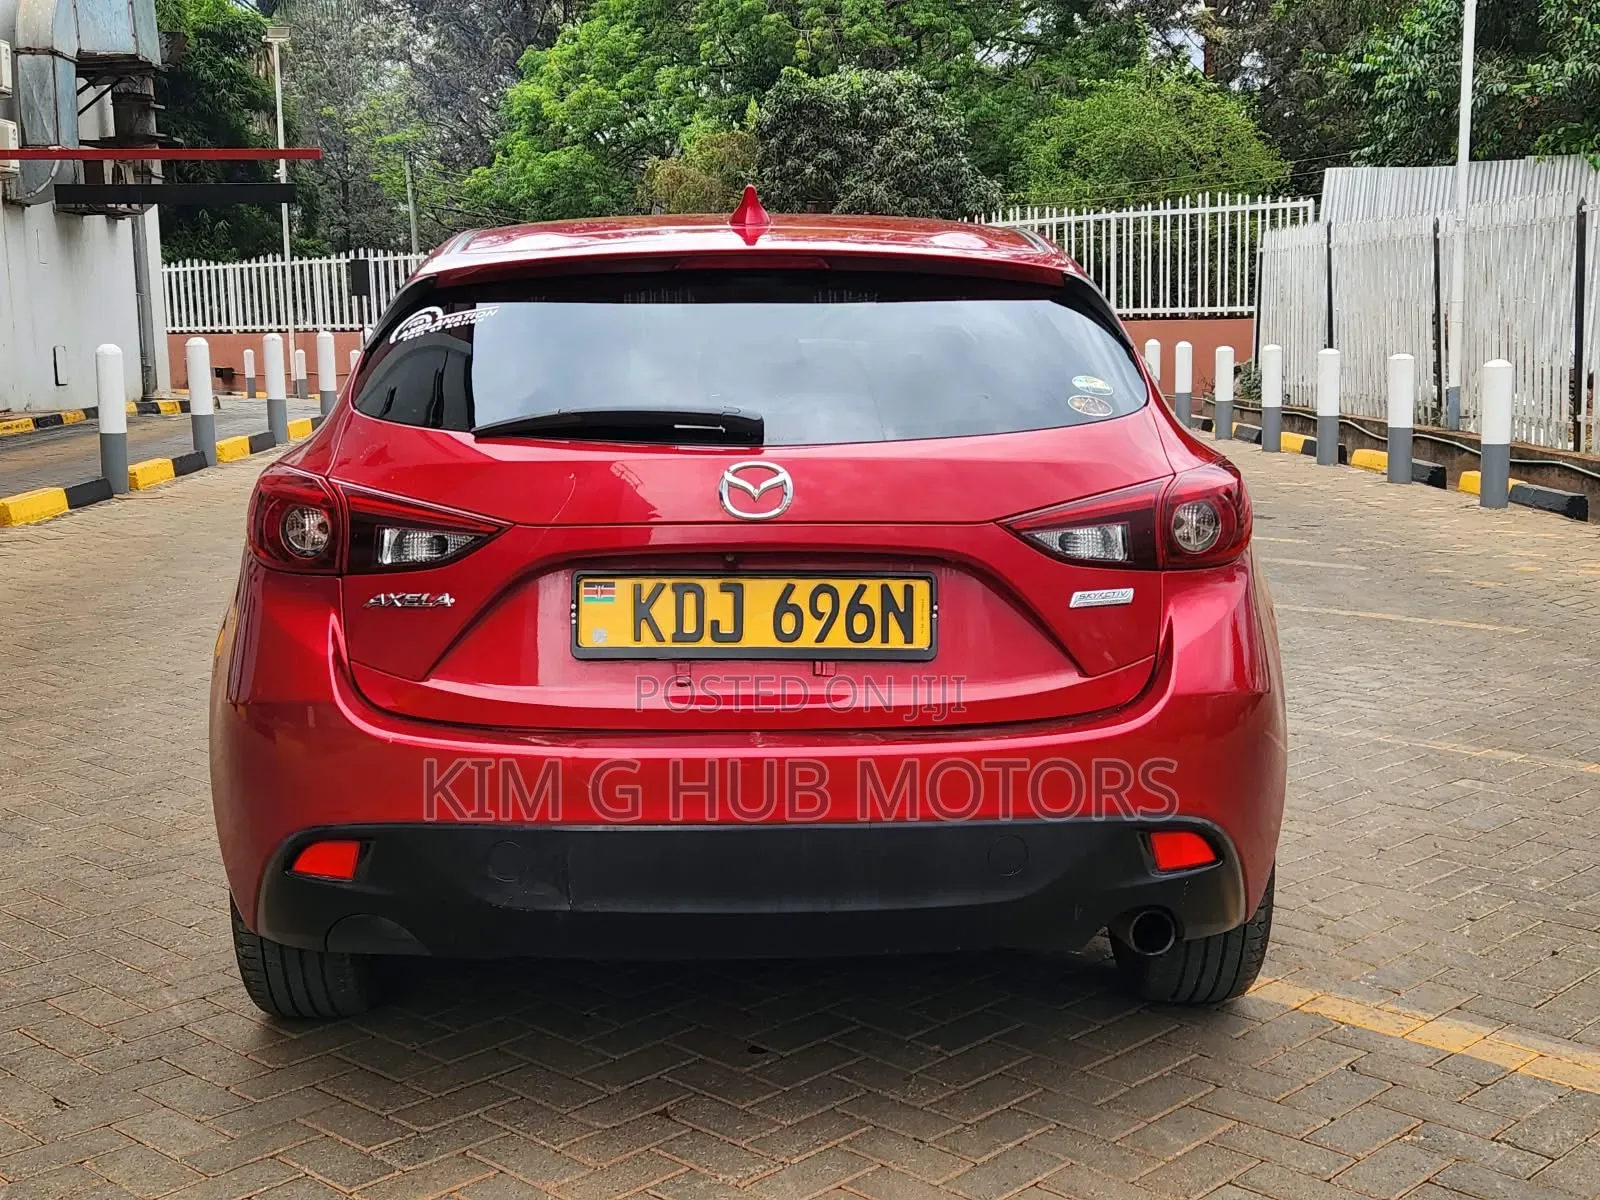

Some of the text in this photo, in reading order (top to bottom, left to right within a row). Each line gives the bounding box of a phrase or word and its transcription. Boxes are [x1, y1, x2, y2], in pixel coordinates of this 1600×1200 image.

[363, 592, 456, 608] AXELA
[632, 582, 744, 643] KDJ
[773, 583, 915, 644] 696N
